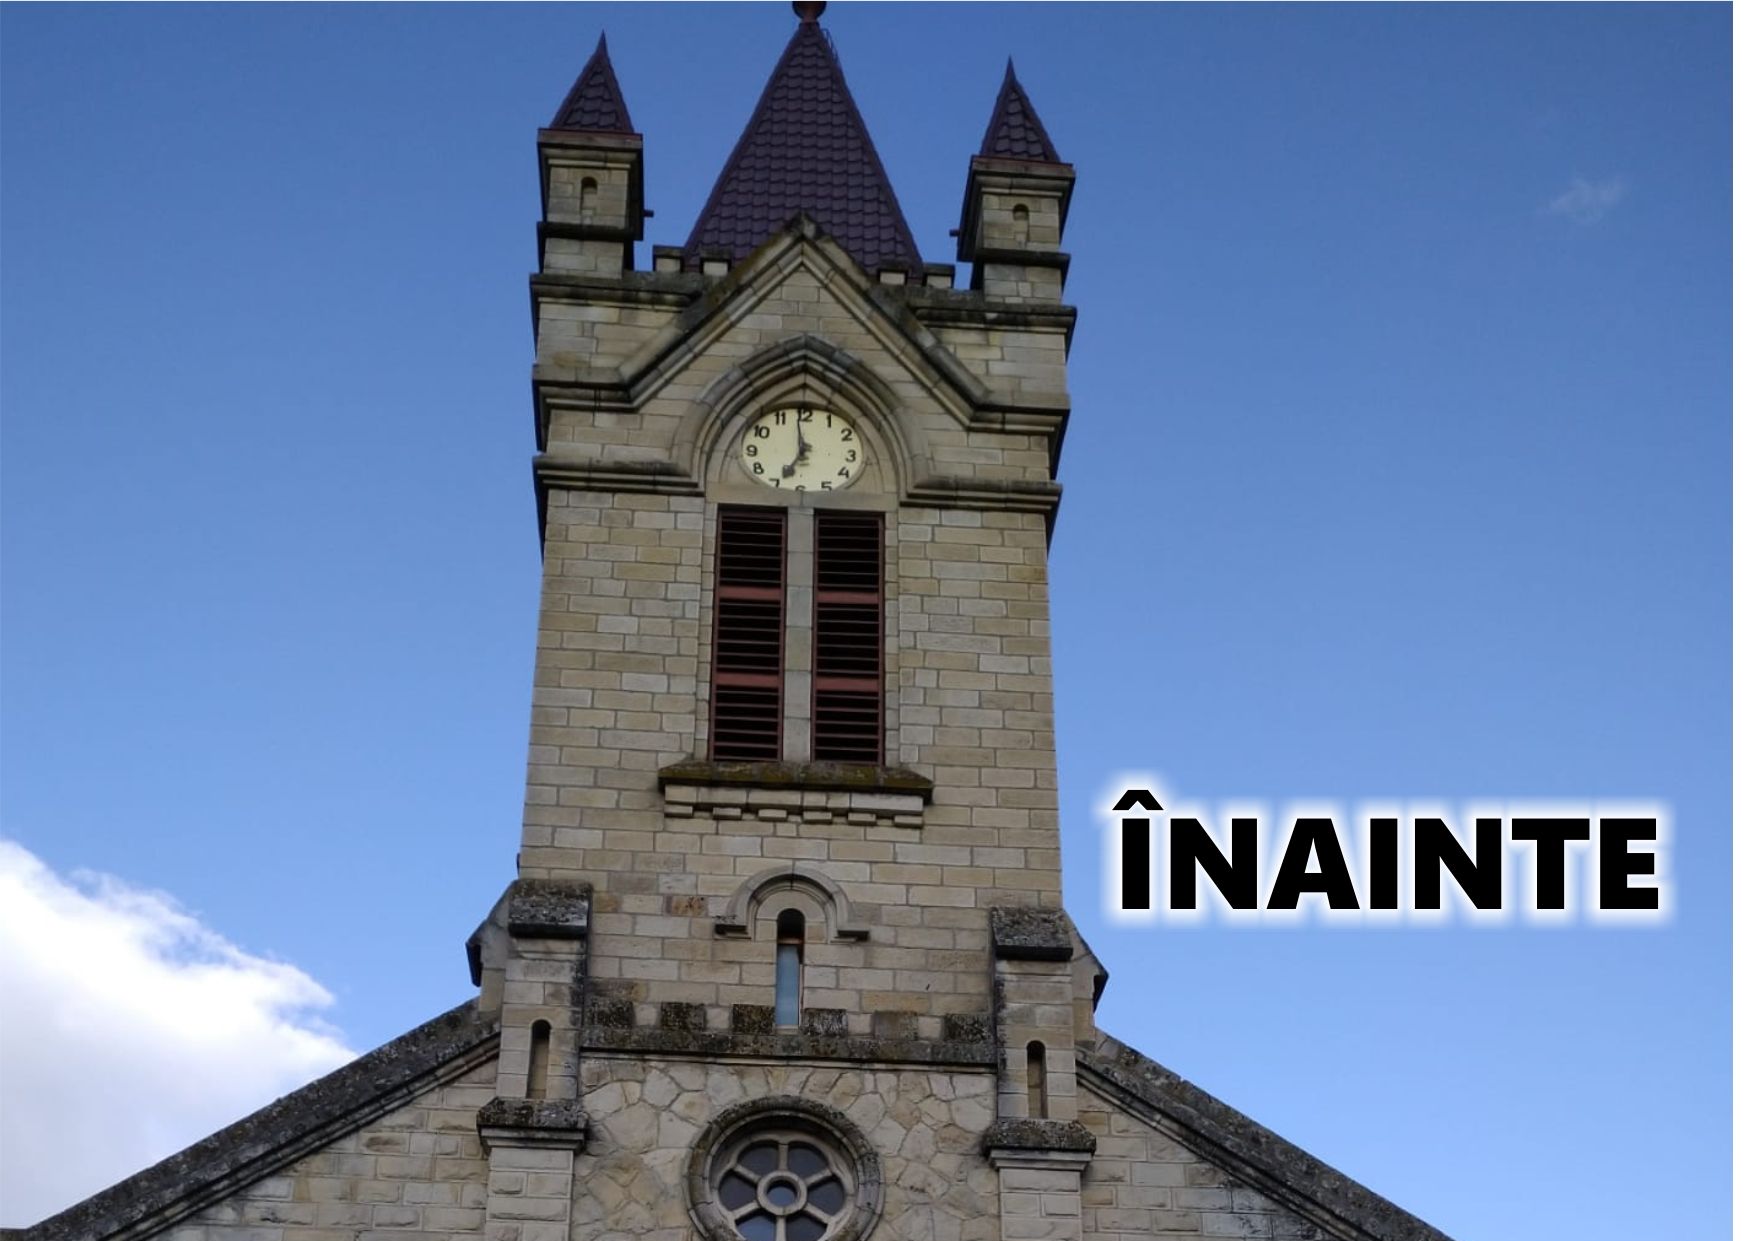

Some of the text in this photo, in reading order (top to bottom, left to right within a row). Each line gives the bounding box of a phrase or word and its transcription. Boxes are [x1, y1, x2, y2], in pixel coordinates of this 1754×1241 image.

[774, 411, 786, 426] 11
[826, 413, 832, 429] 1
[754, 424, 770, 439] 10
[841, 428, 853, 442] 2
[746, 444, 758, 457] 9
[845, 450, 857, 463] 3
[753, 463, 765, 475] 8
[837, 466, 849, 479] 4
[768, 478, 780, 488] 7
[821, 480, 832, 491] 5
